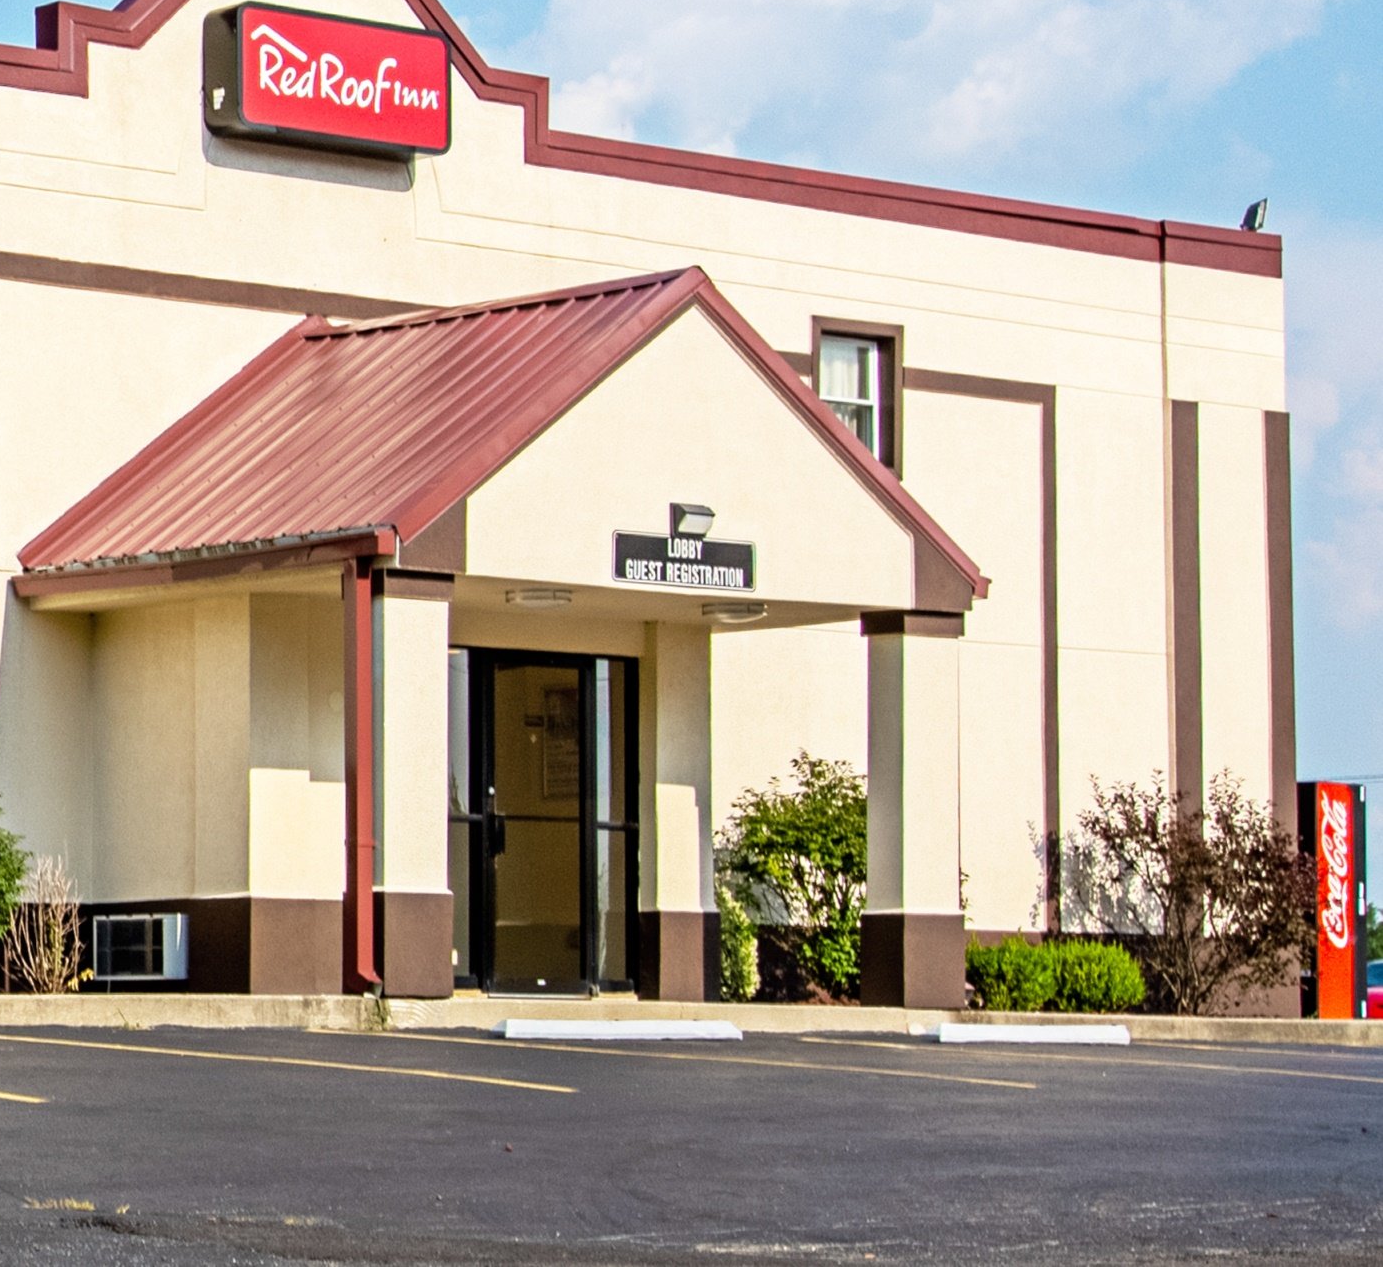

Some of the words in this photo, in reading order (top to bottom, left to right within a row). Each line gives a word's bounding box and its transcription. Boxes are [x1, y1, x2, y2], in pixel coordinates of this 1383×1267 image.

[259, 43, 317, 99] Red
[319, 52, 397, 113] Roof
[668, 538, 702, 560] LOBBY
[625, 559, 663, 581] GUEST
[666, 562, 744, 587] REGISTRATION
